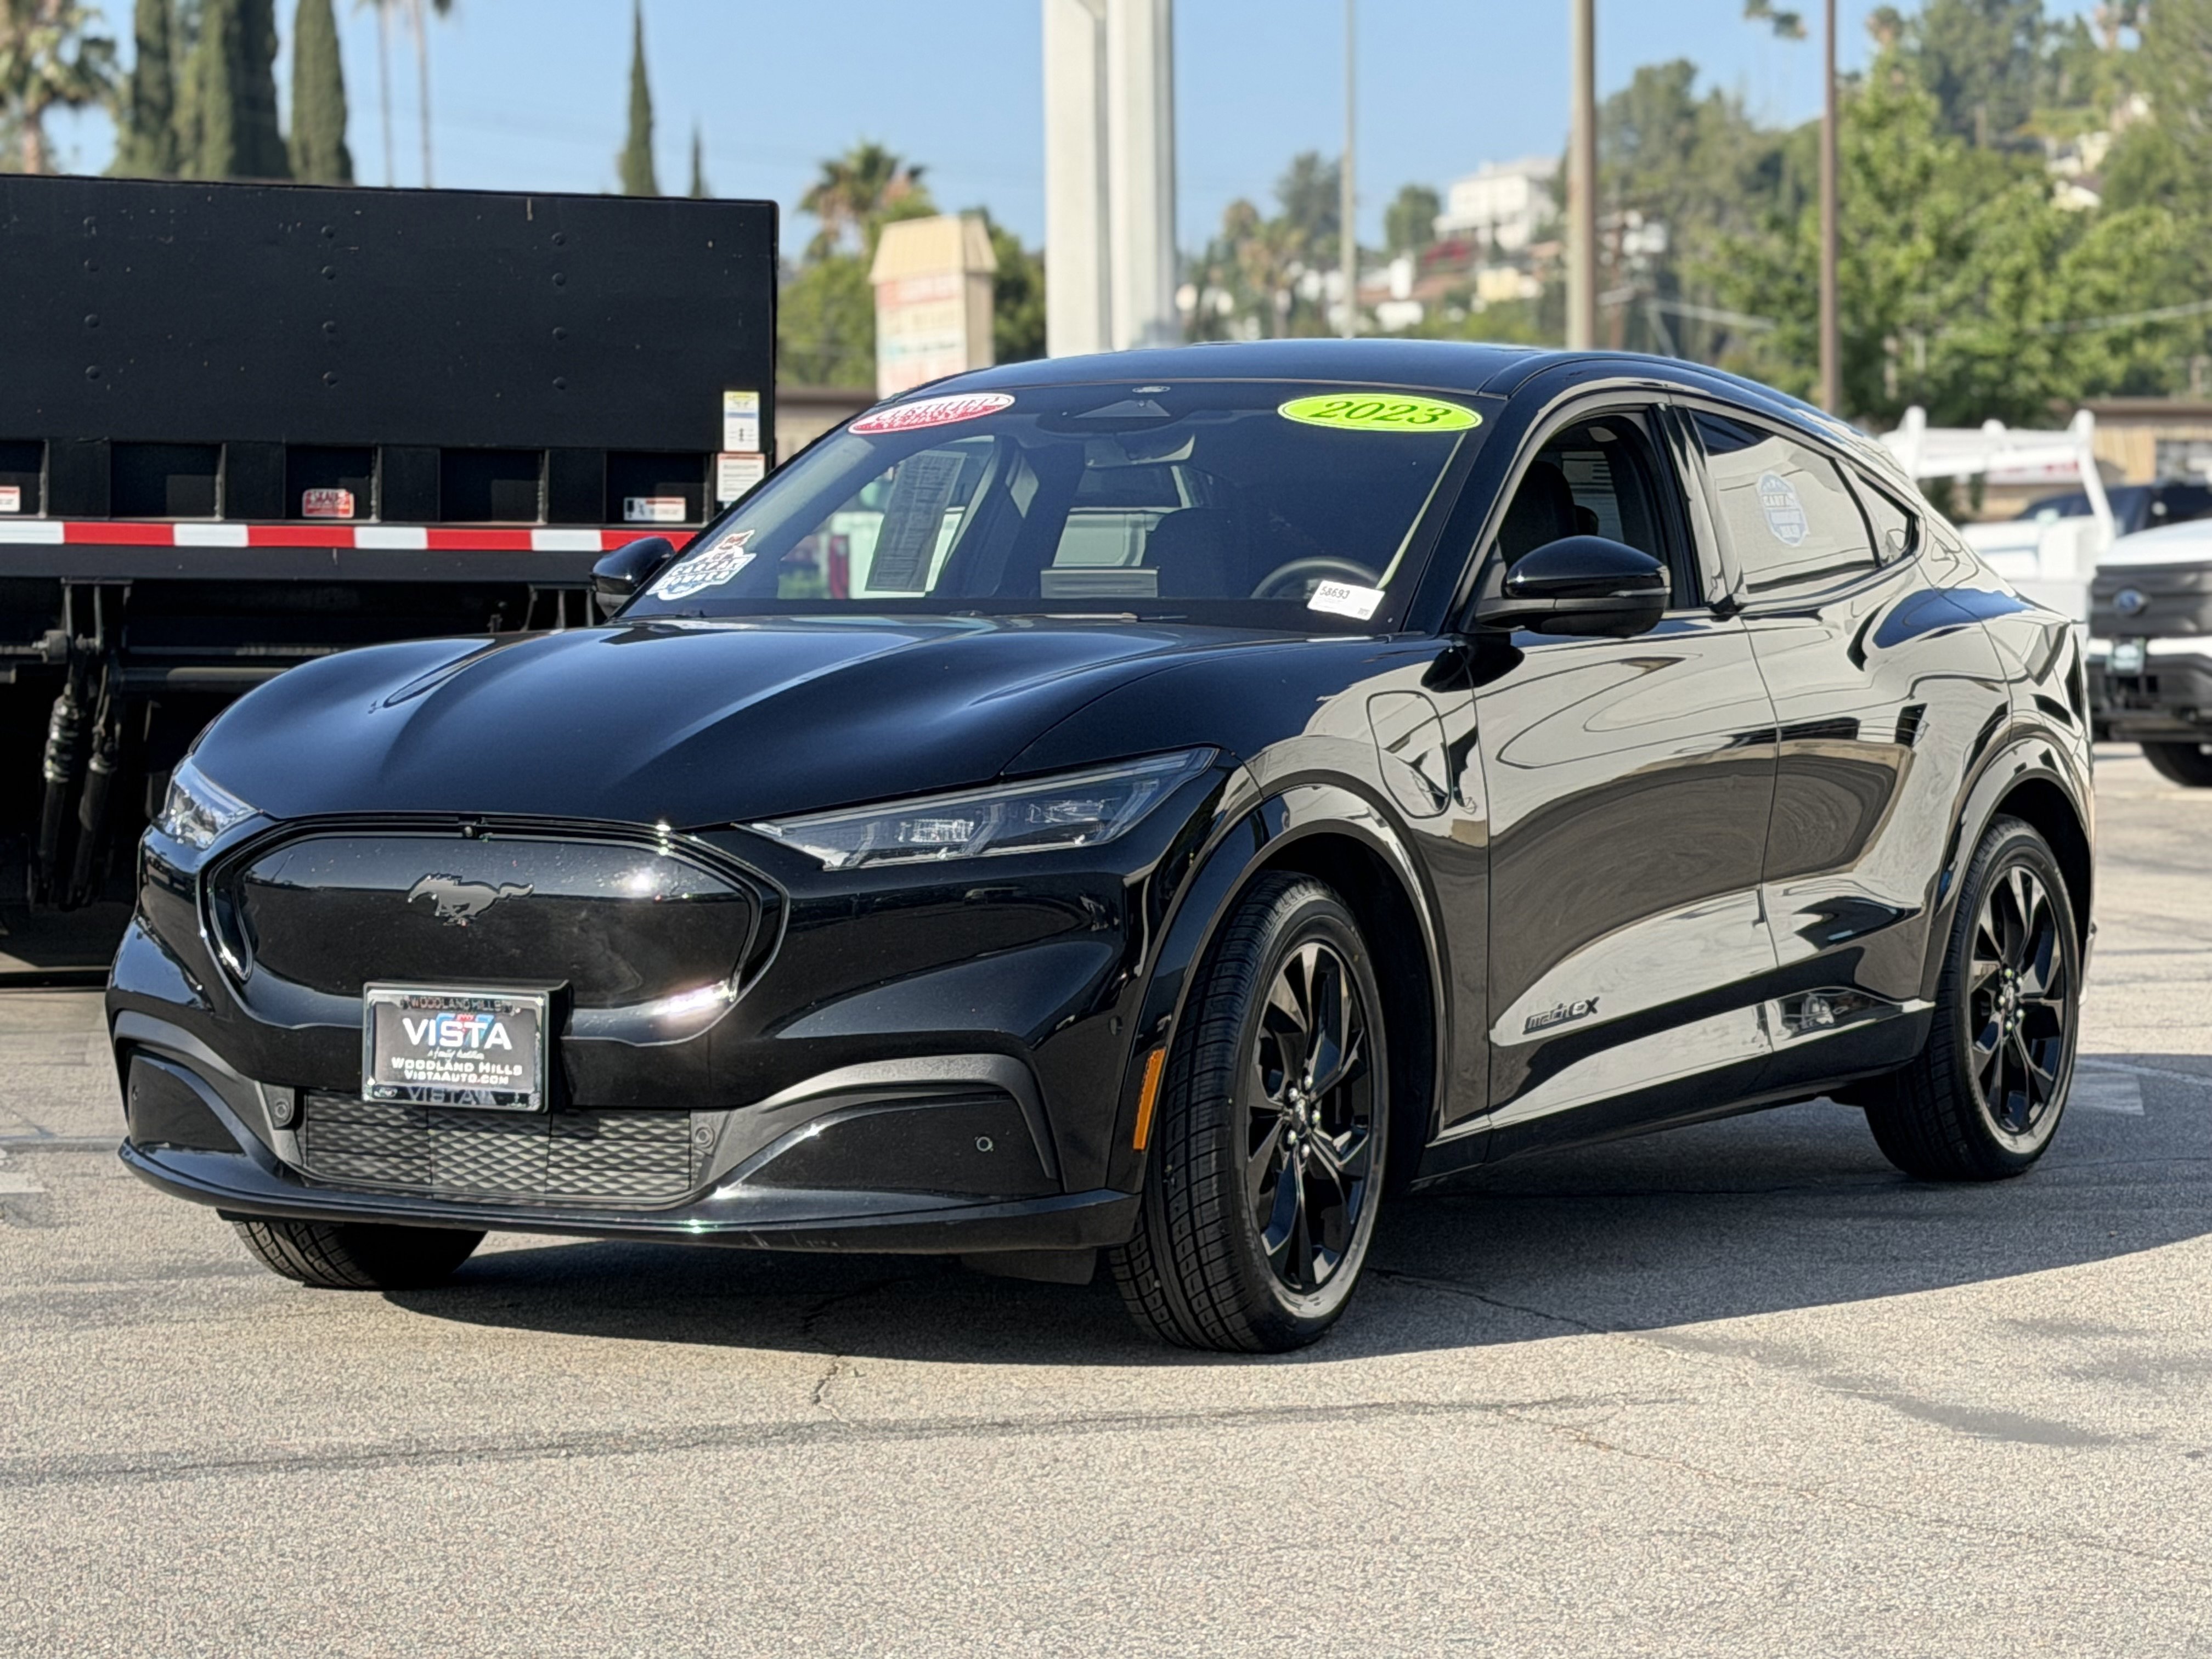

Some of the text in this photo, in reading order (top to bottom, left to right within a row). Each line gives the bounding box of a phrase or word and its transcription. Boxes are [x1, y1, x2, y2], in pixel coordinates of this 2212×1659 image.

[1307, 401, 1452, 424] 2023
[402, 1018, 512, 1050] VISTA
[392, 1057, 522, 1076] WOODLAND HILLS
